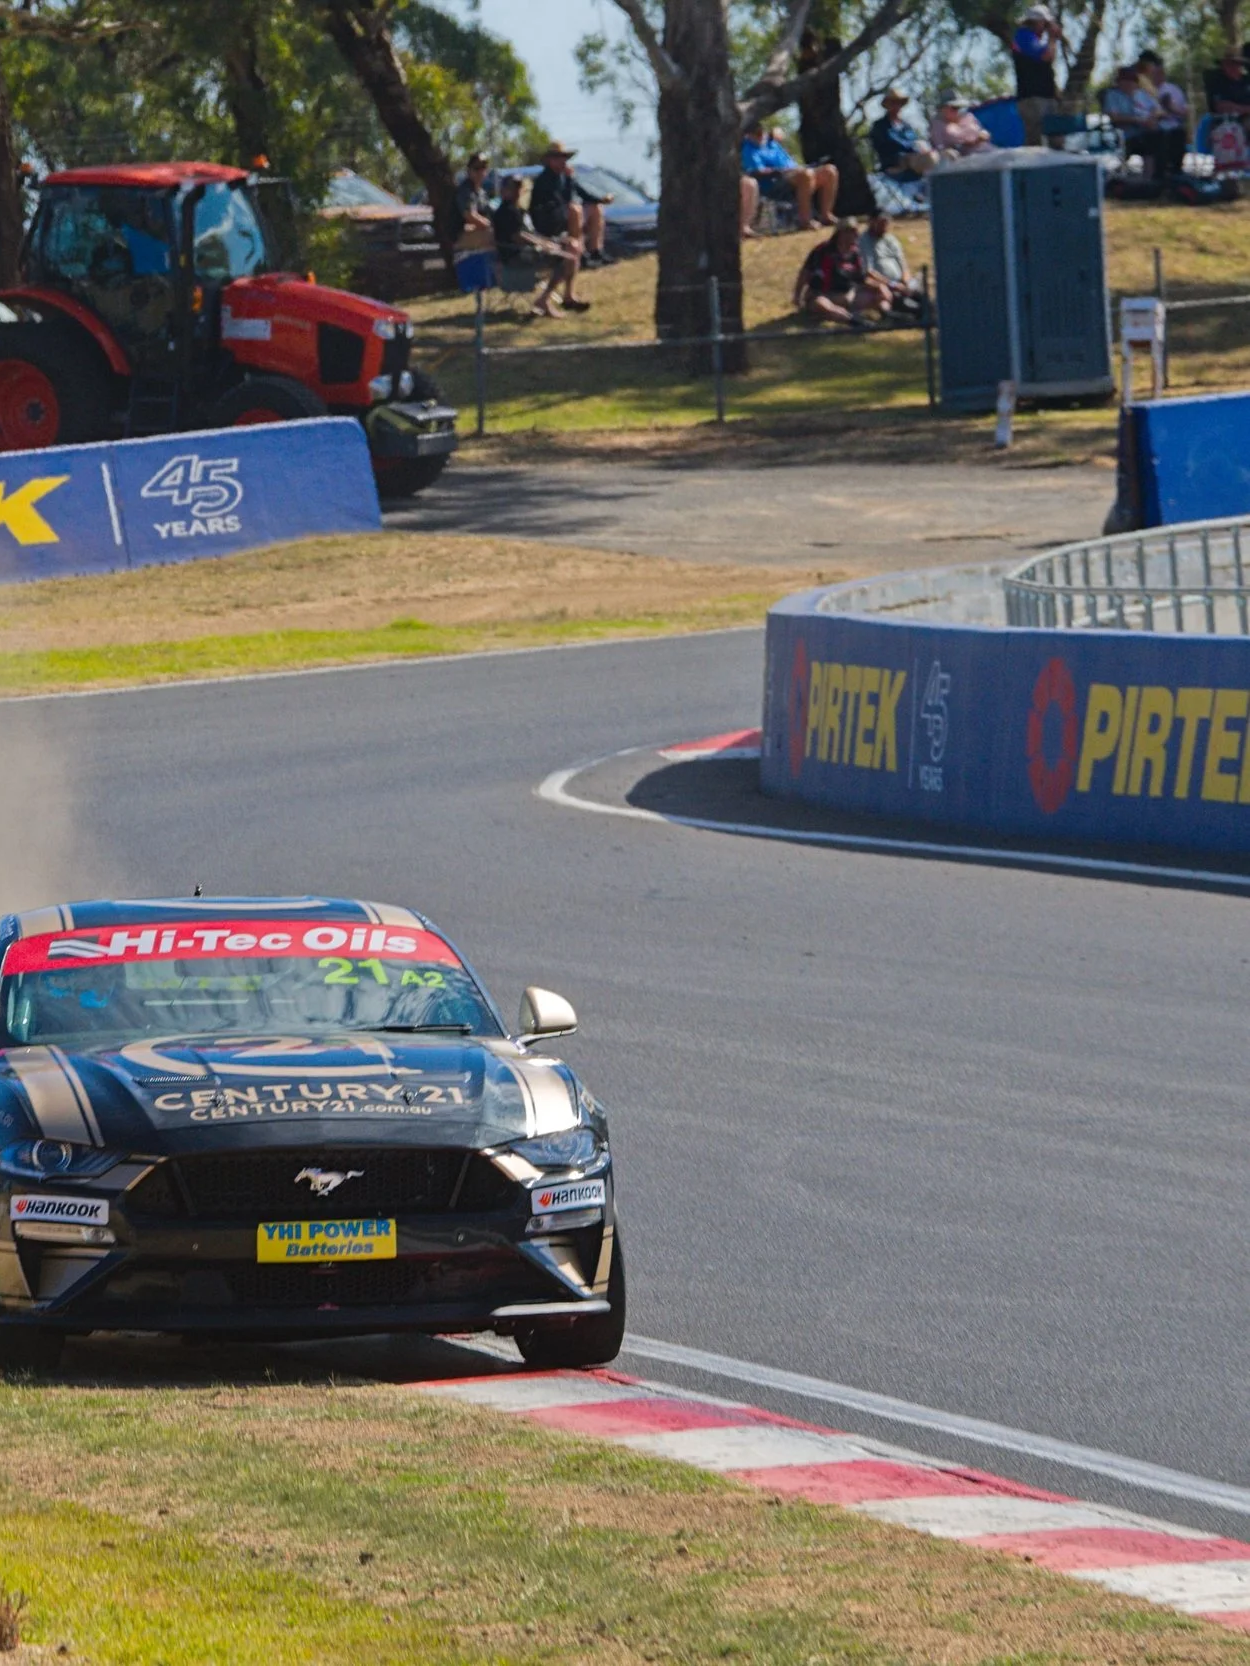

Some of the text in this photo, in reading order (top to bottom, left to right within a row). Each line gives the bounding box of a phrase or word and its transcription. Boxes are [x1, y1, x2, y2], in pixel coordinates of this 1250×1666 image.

[140, 454, 243, 518] 45
[153, 515, 242, 539] YEARS
[805, 661, 907, 773] PIRTEK
[1076, 683, 1250, 804] PIRTE
[107, 927, 417, 956] Hi-Tec Oils
[318, 957, 447, 989] 21 A2
[154, 1083, 464, 1111] CENTURY 21
[263, 1219, 391, 1240] YHI POWER
[286, 1241, 374, 1257] Batteries
